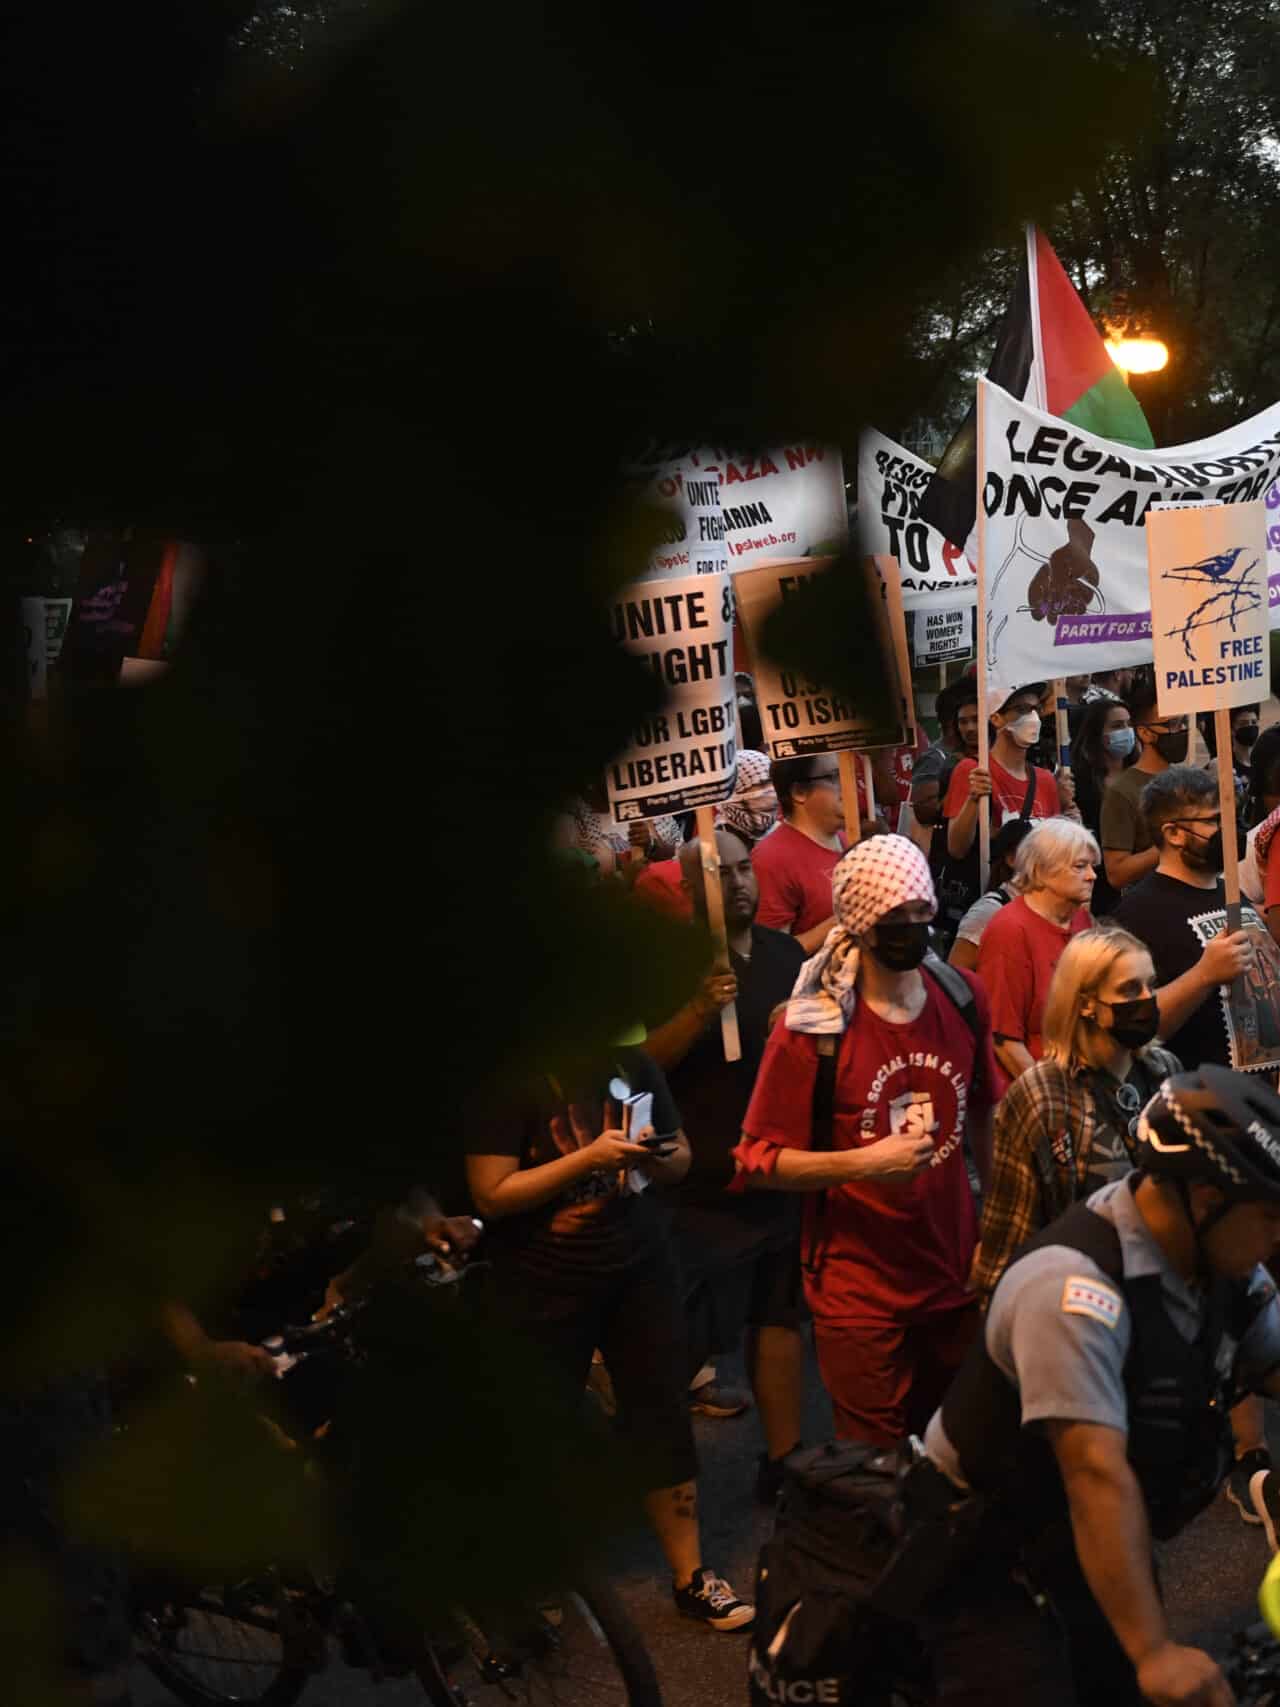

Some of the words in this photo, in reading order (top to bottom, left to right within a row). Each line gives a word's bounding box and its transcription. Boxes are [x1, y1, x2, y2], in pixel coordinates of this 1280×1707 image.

[875, 449, 934, 489] RESIS
[983, 472, 1099, 520] ONCE
[720, 501, 773, 532] ARINA
[881, 513, 931, 572] TO
[609, 591, 710, 643] UNITE
[926, 623, 964, 641] WOMEN'S
[927, 614, 945, 627] HAS
[946, 612, 964, 624] WON
[1060, 622, 1107, 640] PARTY
[1107, 621, 1135, 637] FOR
[929, 637, 960, 653] RIGHTS!
[1220, 636, 1264, 659] FREE
[1166, 660, 1264, 689] PALESTINE
[630, 714, 671, 748] OR
[677, 700, 736, 739] LGBT
[767, 701, 799, 731] TO
[859, 1107, 878, 1140] FOR
[939, 1060, 953, 1076] &
